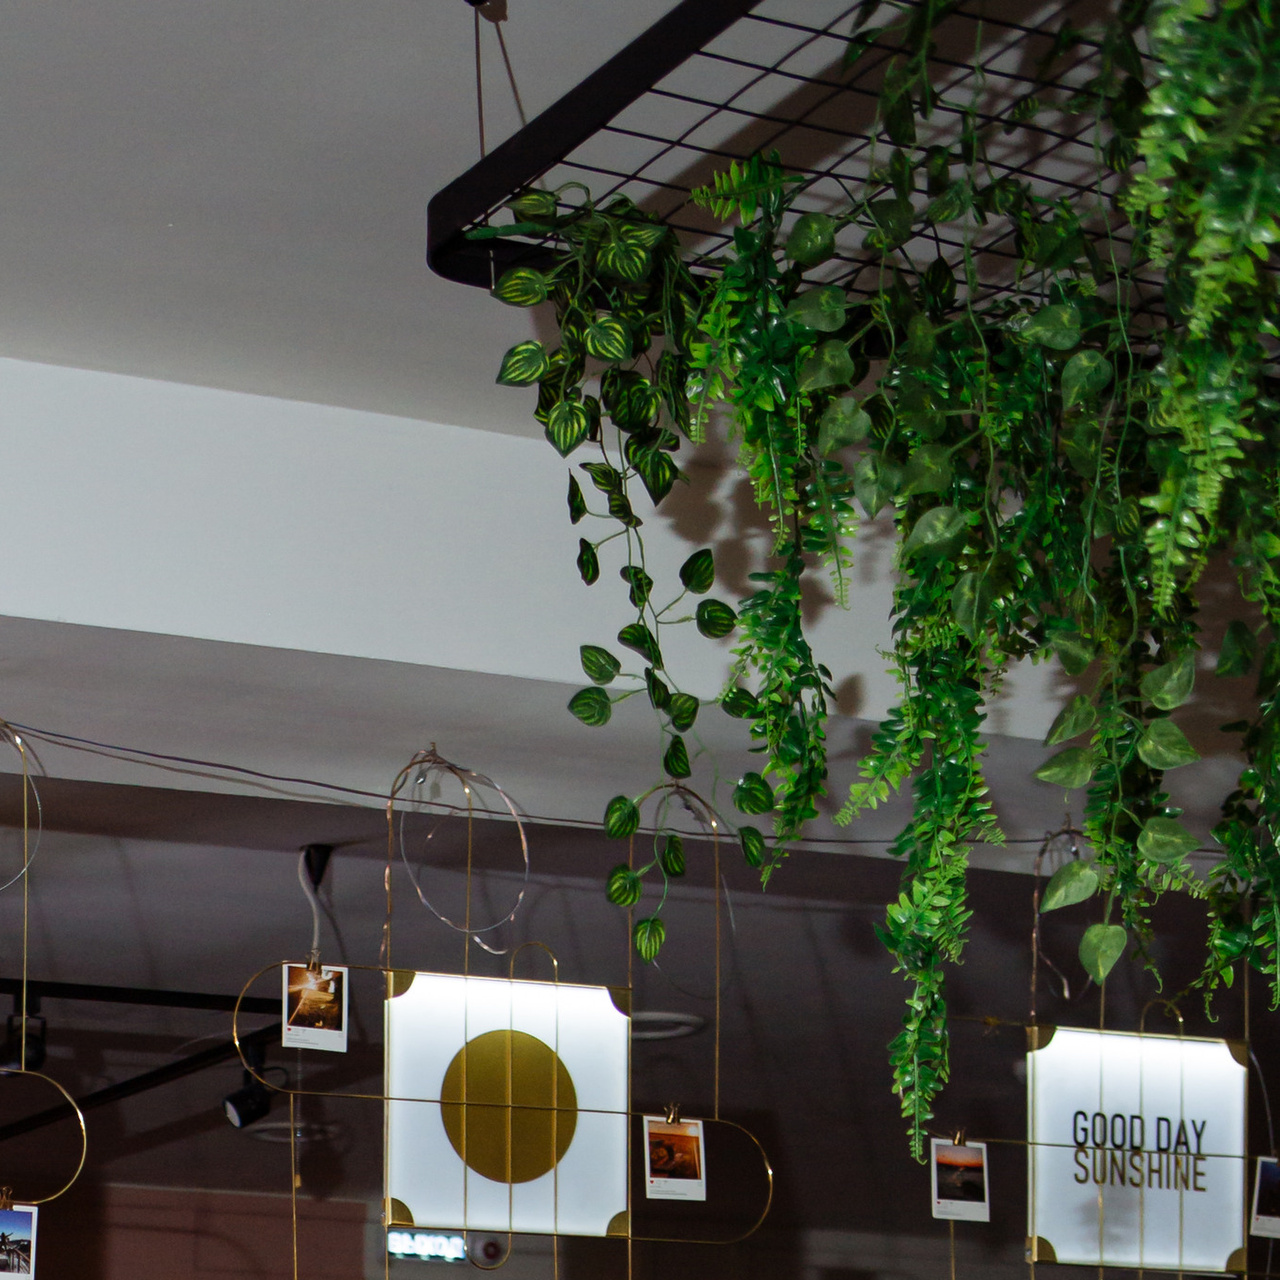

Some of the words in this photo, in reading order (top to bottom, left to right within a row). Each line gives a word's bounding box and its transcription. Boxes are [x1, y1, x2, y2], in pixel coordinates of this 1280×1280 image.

[1072, 1110, 1144, 1150] GOOD
[1157, 1117, 1206, 1154] DAY
[1074, 1148, 1206, 1192] SUNSHINE
